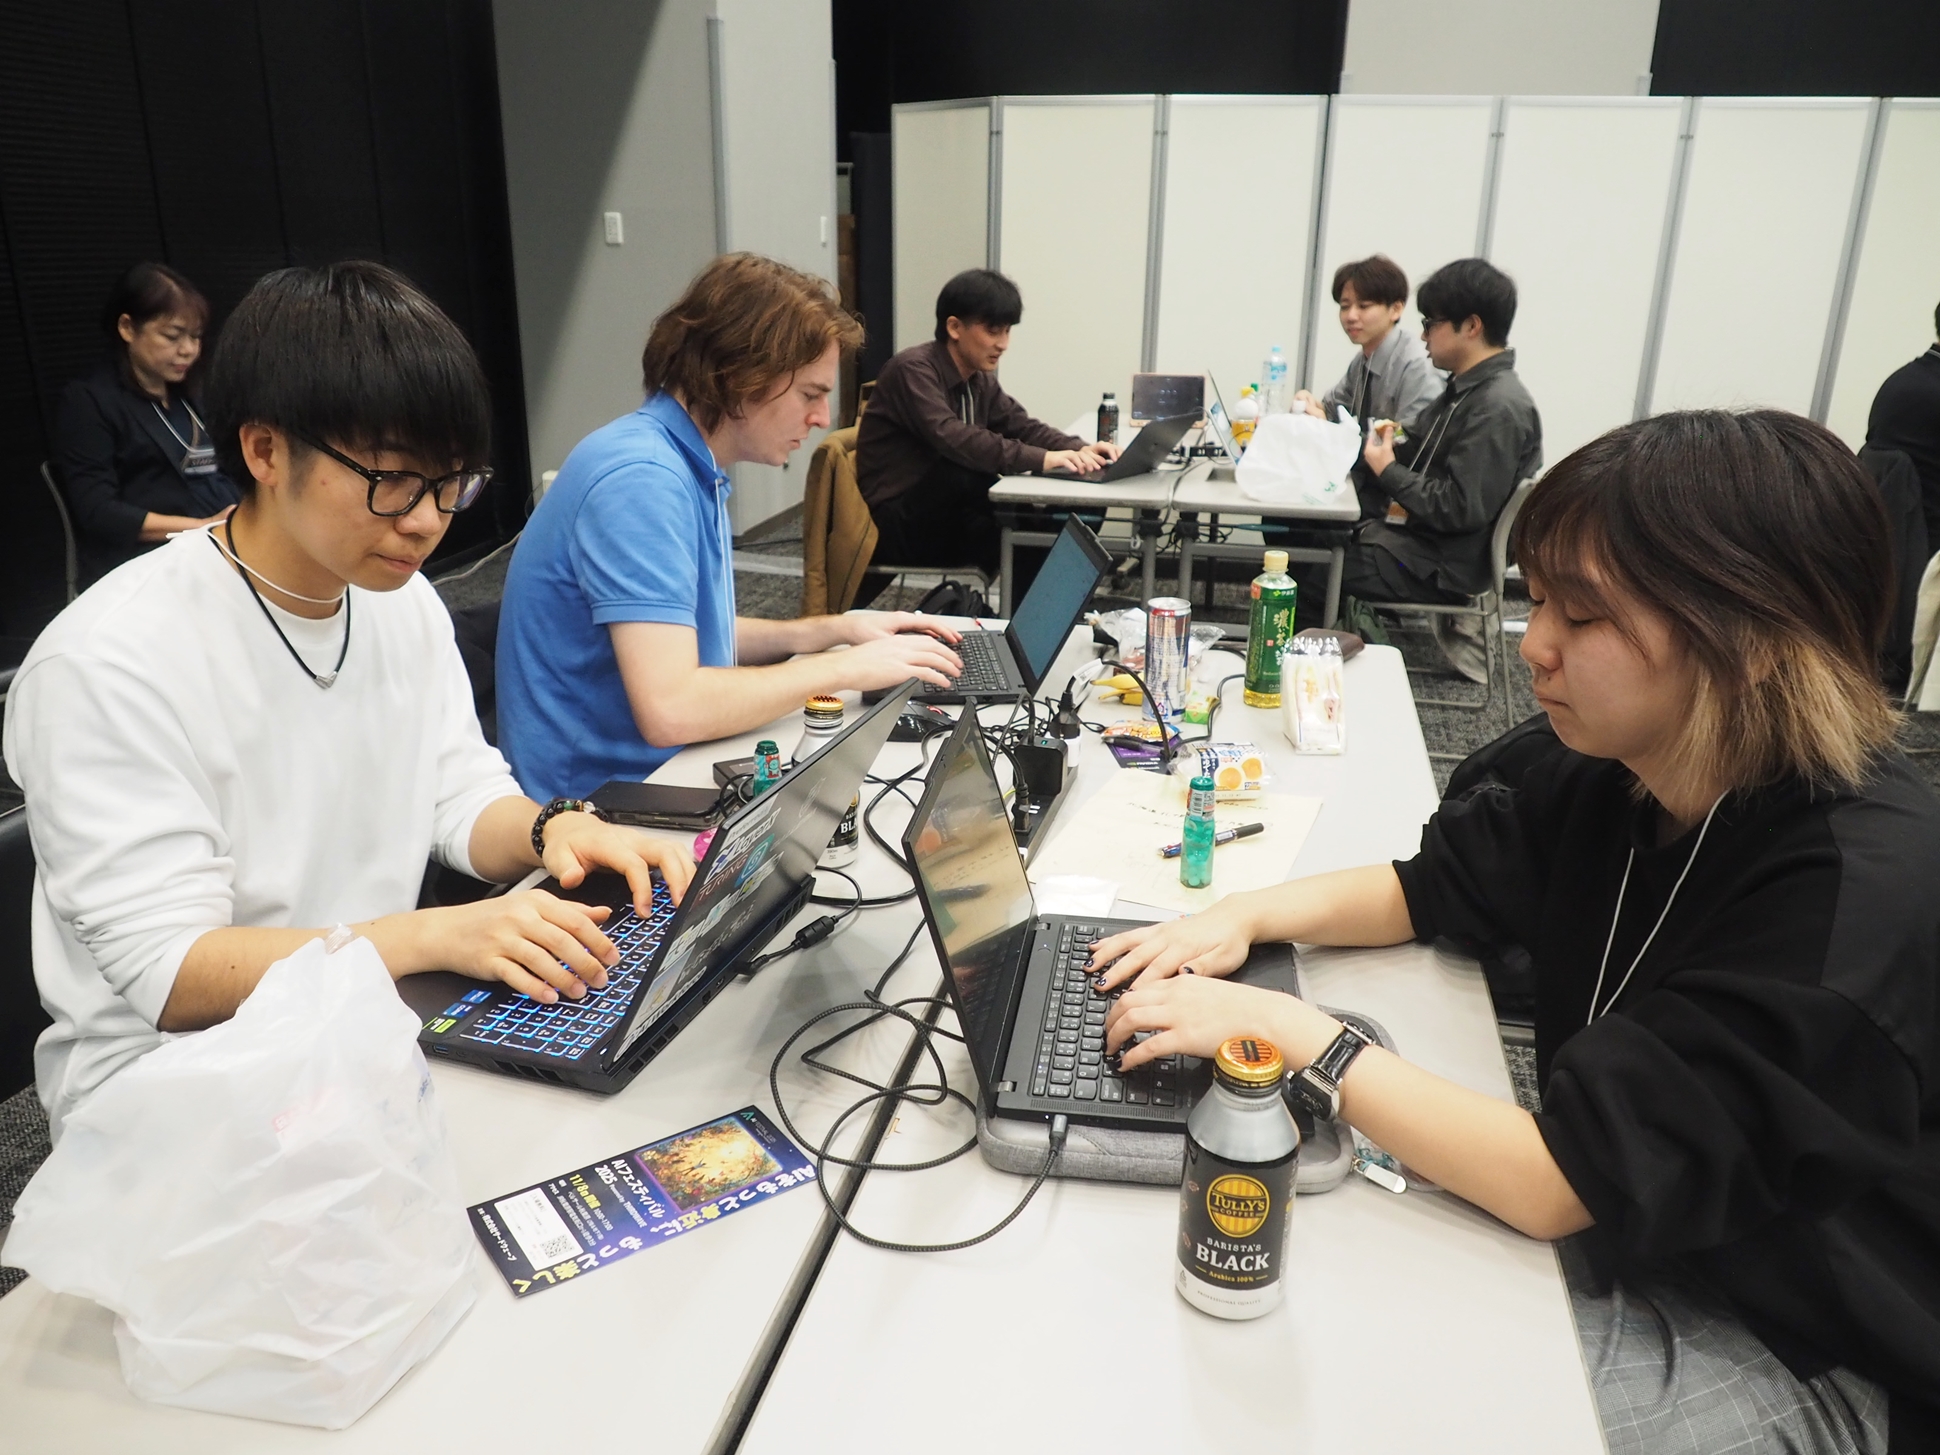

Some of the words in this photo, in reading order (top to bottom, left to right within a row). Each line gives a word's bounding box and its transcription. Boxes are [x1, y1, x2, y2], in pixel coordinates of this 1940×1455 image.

[841, 818, 857, 834] BLA
[698, 853, 748, 902] TURING
[594, 1164, 618, 1184] 2025
[611, 1159, 665, 1218] AIフェスティバル
[1212, 1192, 1265, 1212] TULLY'S
[1220, 1208, 1255, 1217] COFFEE
[1207, 1237, 1262, 1252] BARISTA'S
[1195, 1242, 1270, 1272] BLACK
[1209, 1270, 1235, 1282] Arabica
